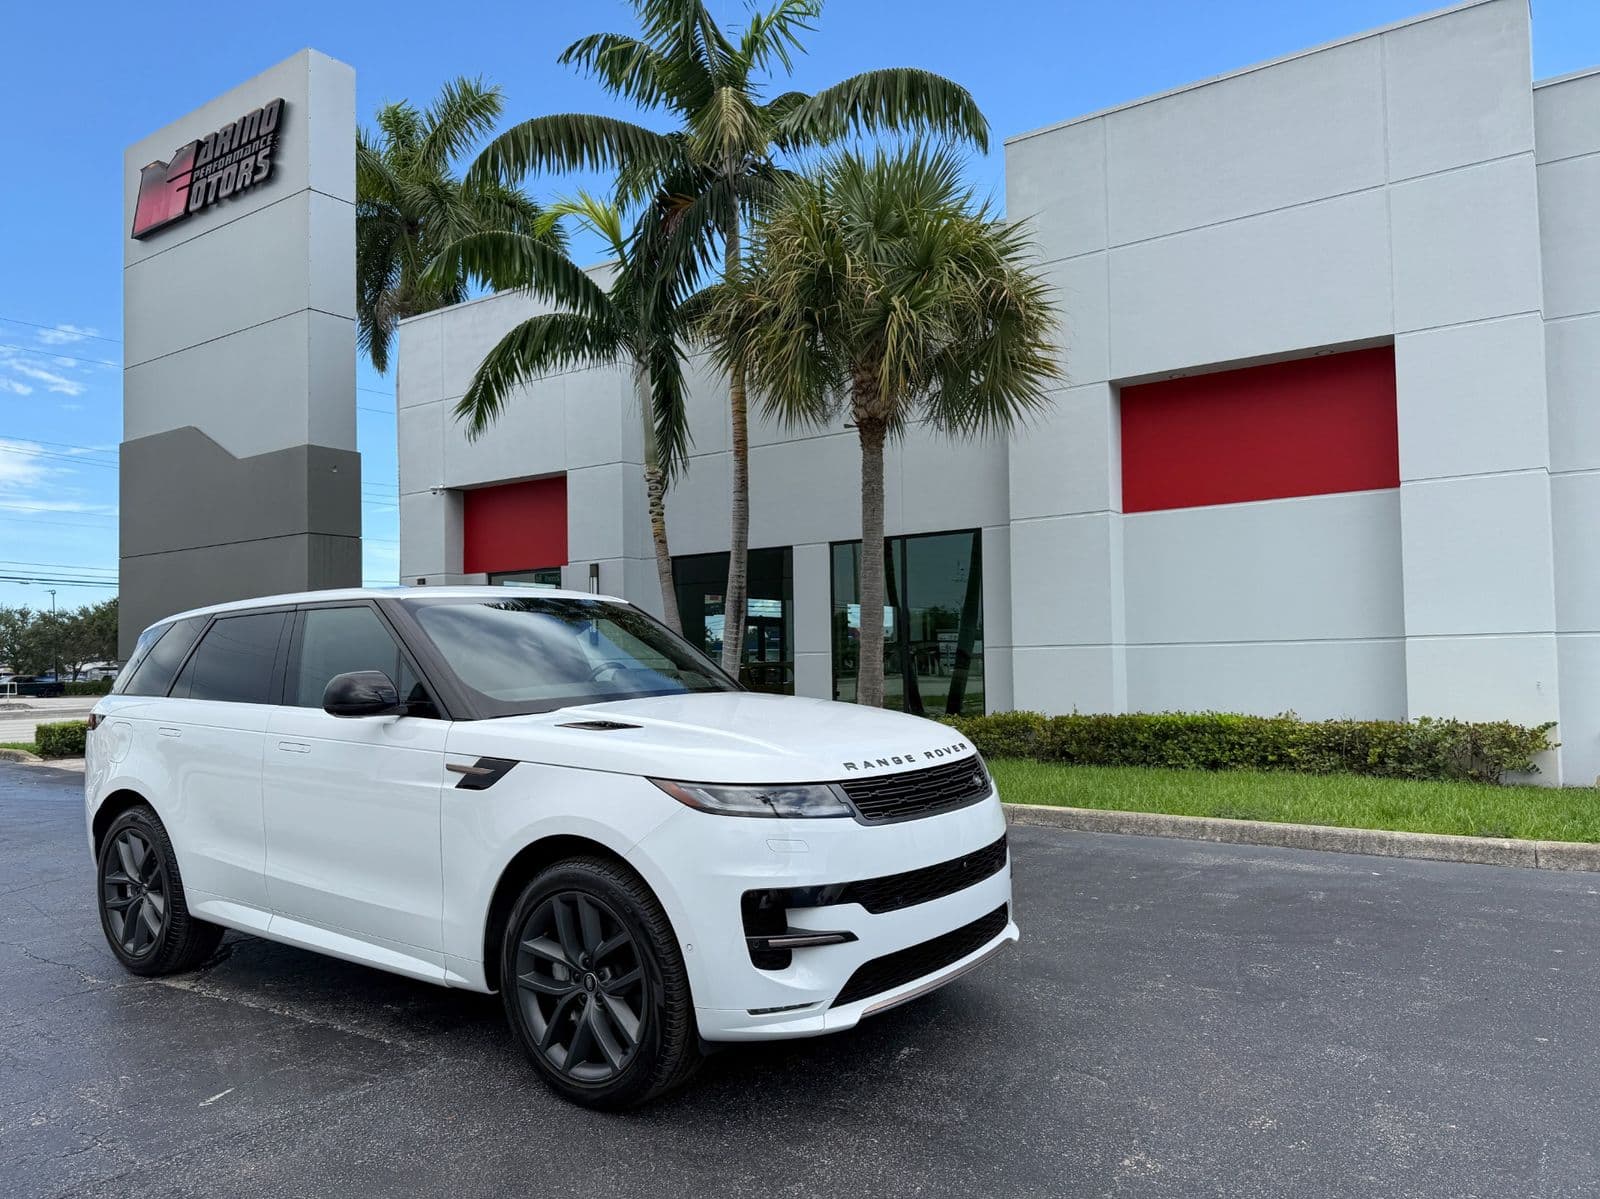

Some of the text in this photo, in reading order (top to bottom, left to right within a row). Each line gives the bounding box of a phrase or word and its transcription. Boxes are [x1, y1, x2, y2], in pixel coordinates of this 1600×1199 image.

[192, 132, 274, 182] PERFORMANCE
[843, 742, 968, 771] RANGE ROVER
